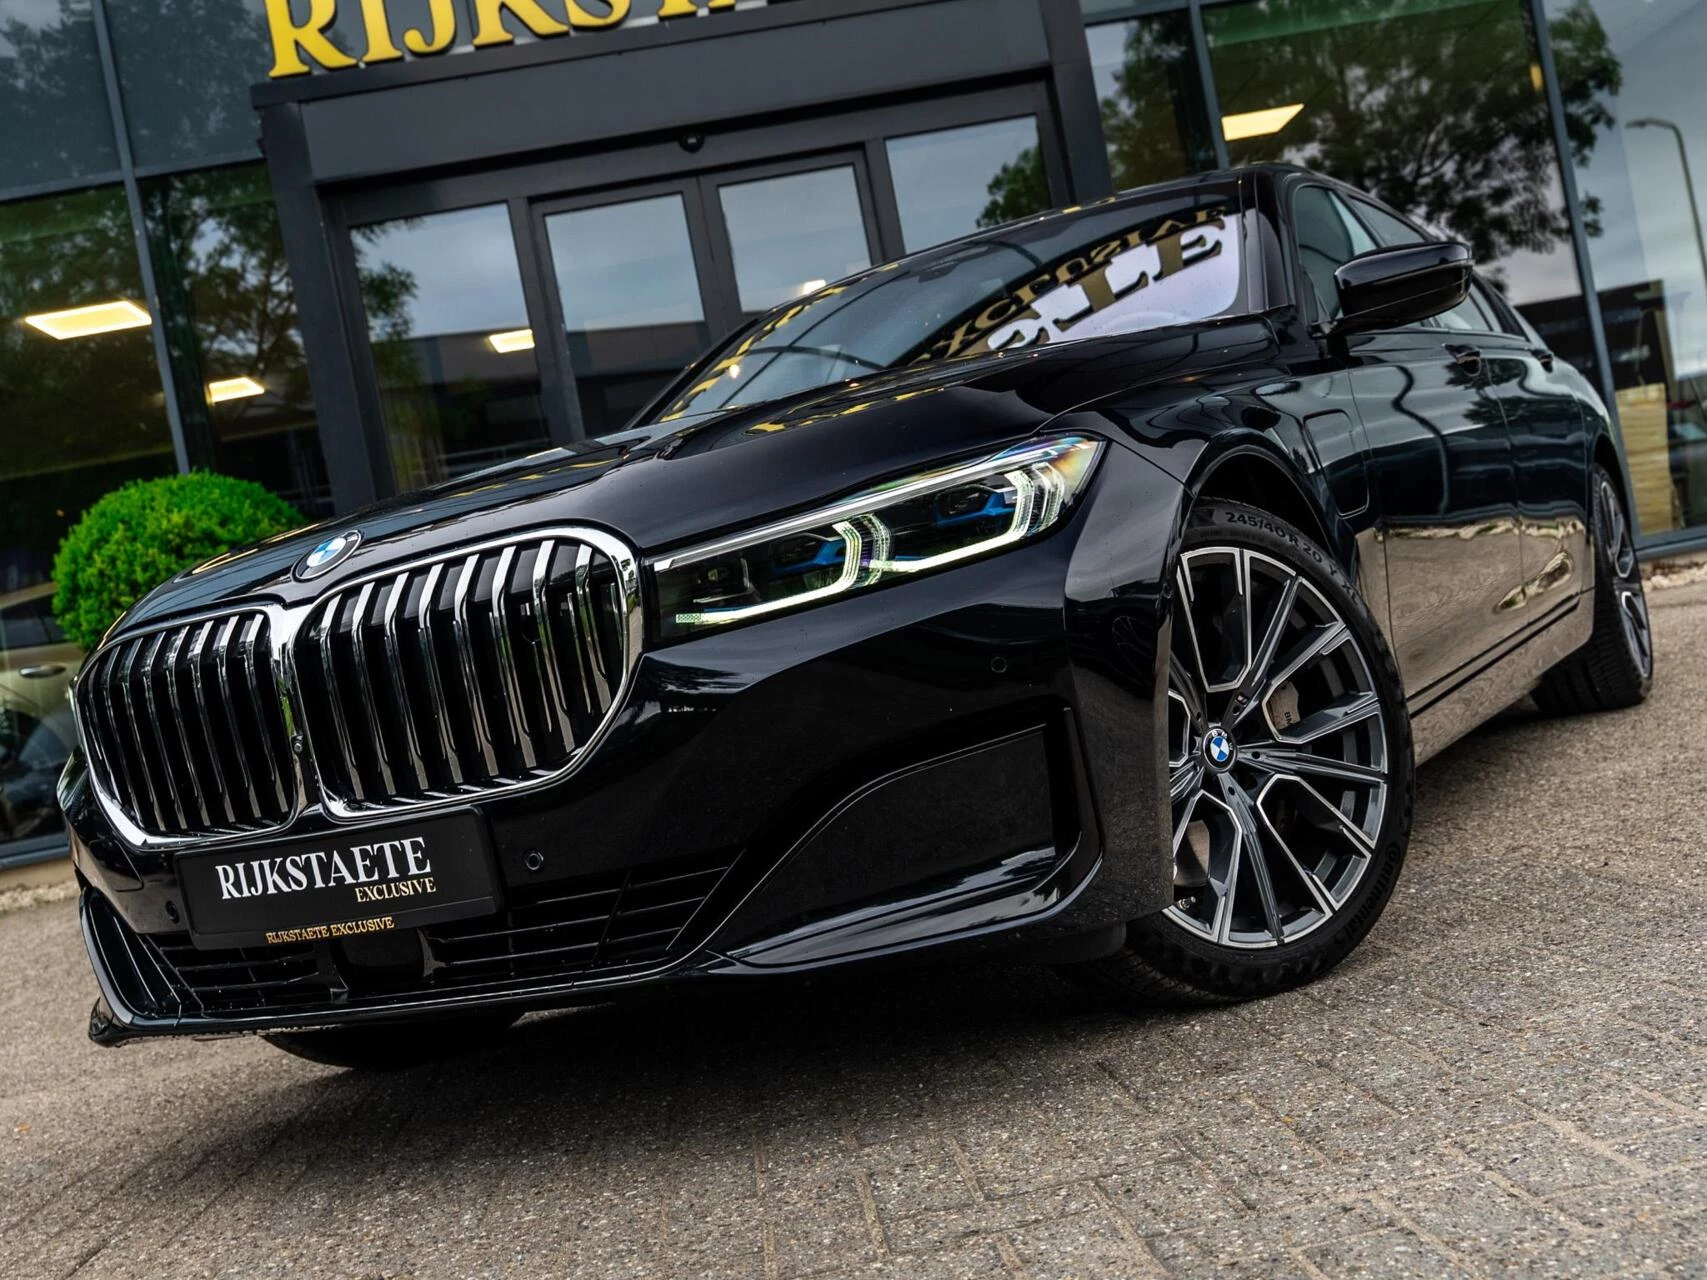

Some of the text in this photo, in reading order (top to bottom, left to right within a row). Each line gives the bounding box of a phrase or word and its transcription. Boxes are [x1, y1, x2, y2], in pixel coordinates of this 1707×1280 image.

[1225, 511, 1286, 539] 245/40
[1289, 532, 1299, 547] R
[1302, 542, 1323, 564] 20
[215, 836, 432, 900] RIJKSTAETE
[354, 877, 437, 903] EXCLUSIVE
[265, 916, 395, 944] RIJKSTAETE EXCLUSIVE
